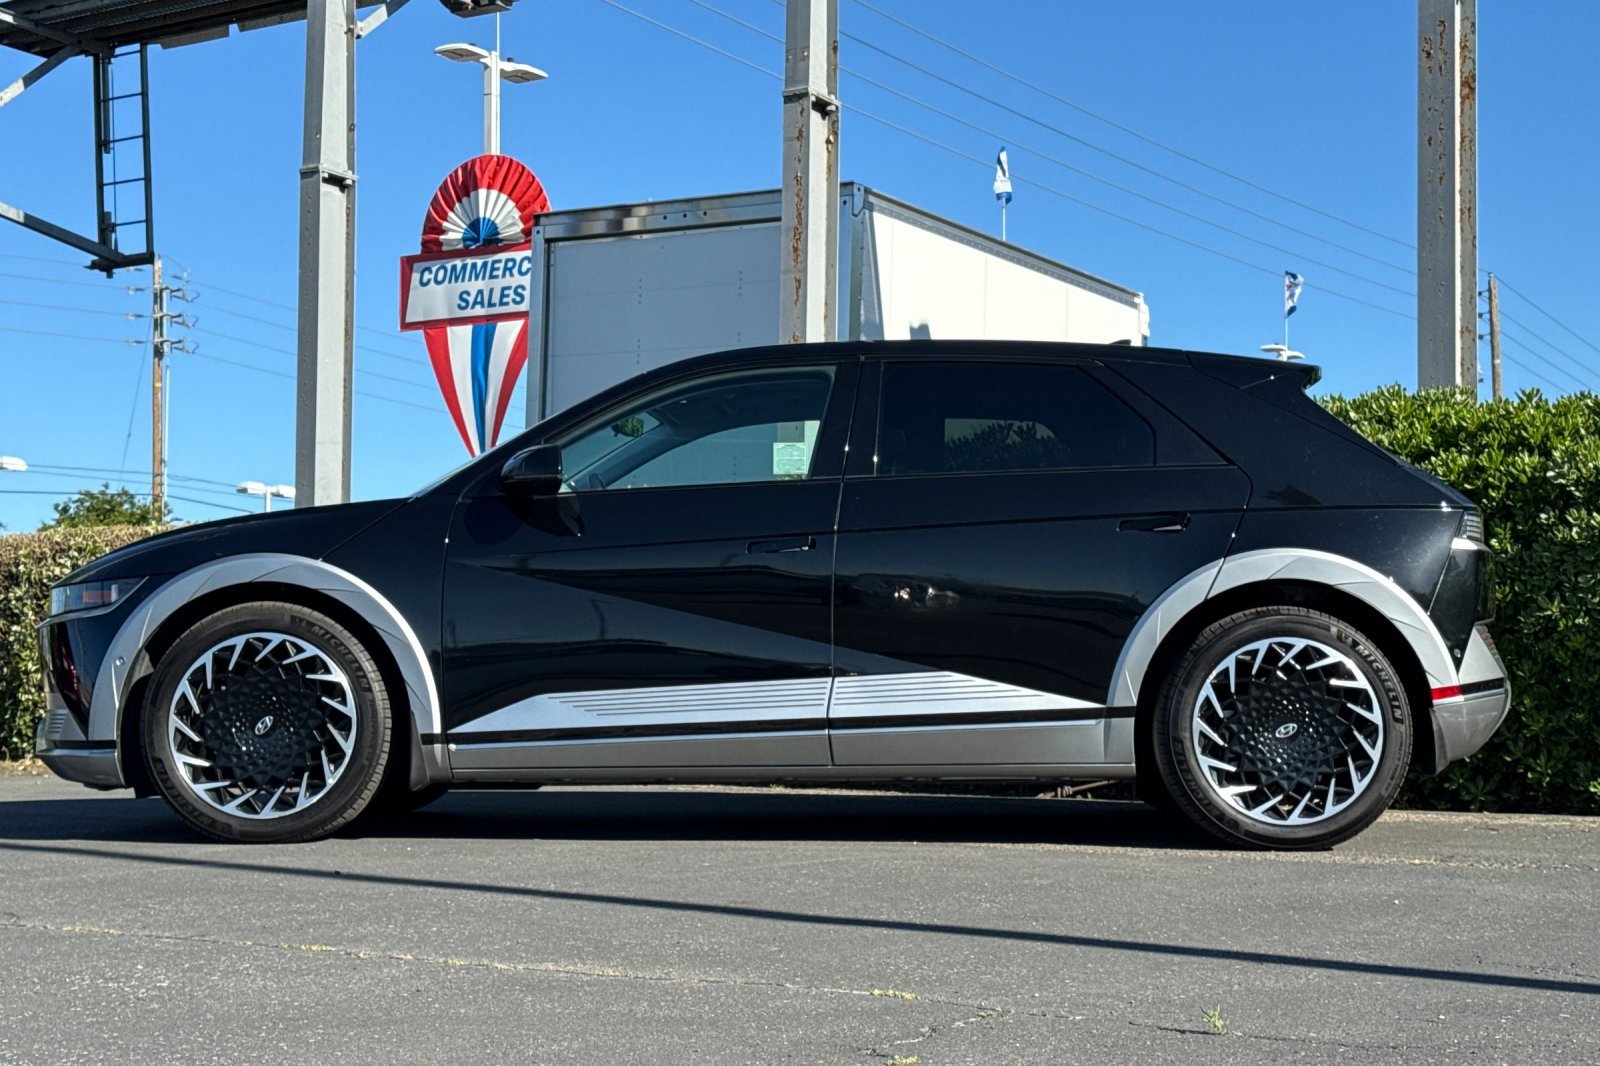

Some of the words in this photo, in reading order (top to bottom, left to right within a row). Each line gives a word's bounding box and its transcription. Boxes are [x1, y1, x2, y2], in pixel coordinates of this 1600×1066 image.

[418, 255, 532, 287] COMMERC
[457, 284, 527, 311] SALES
[311, 625, 370, 692] MICHELIN
[1355, 644, 1403, 720] MICHELIN
